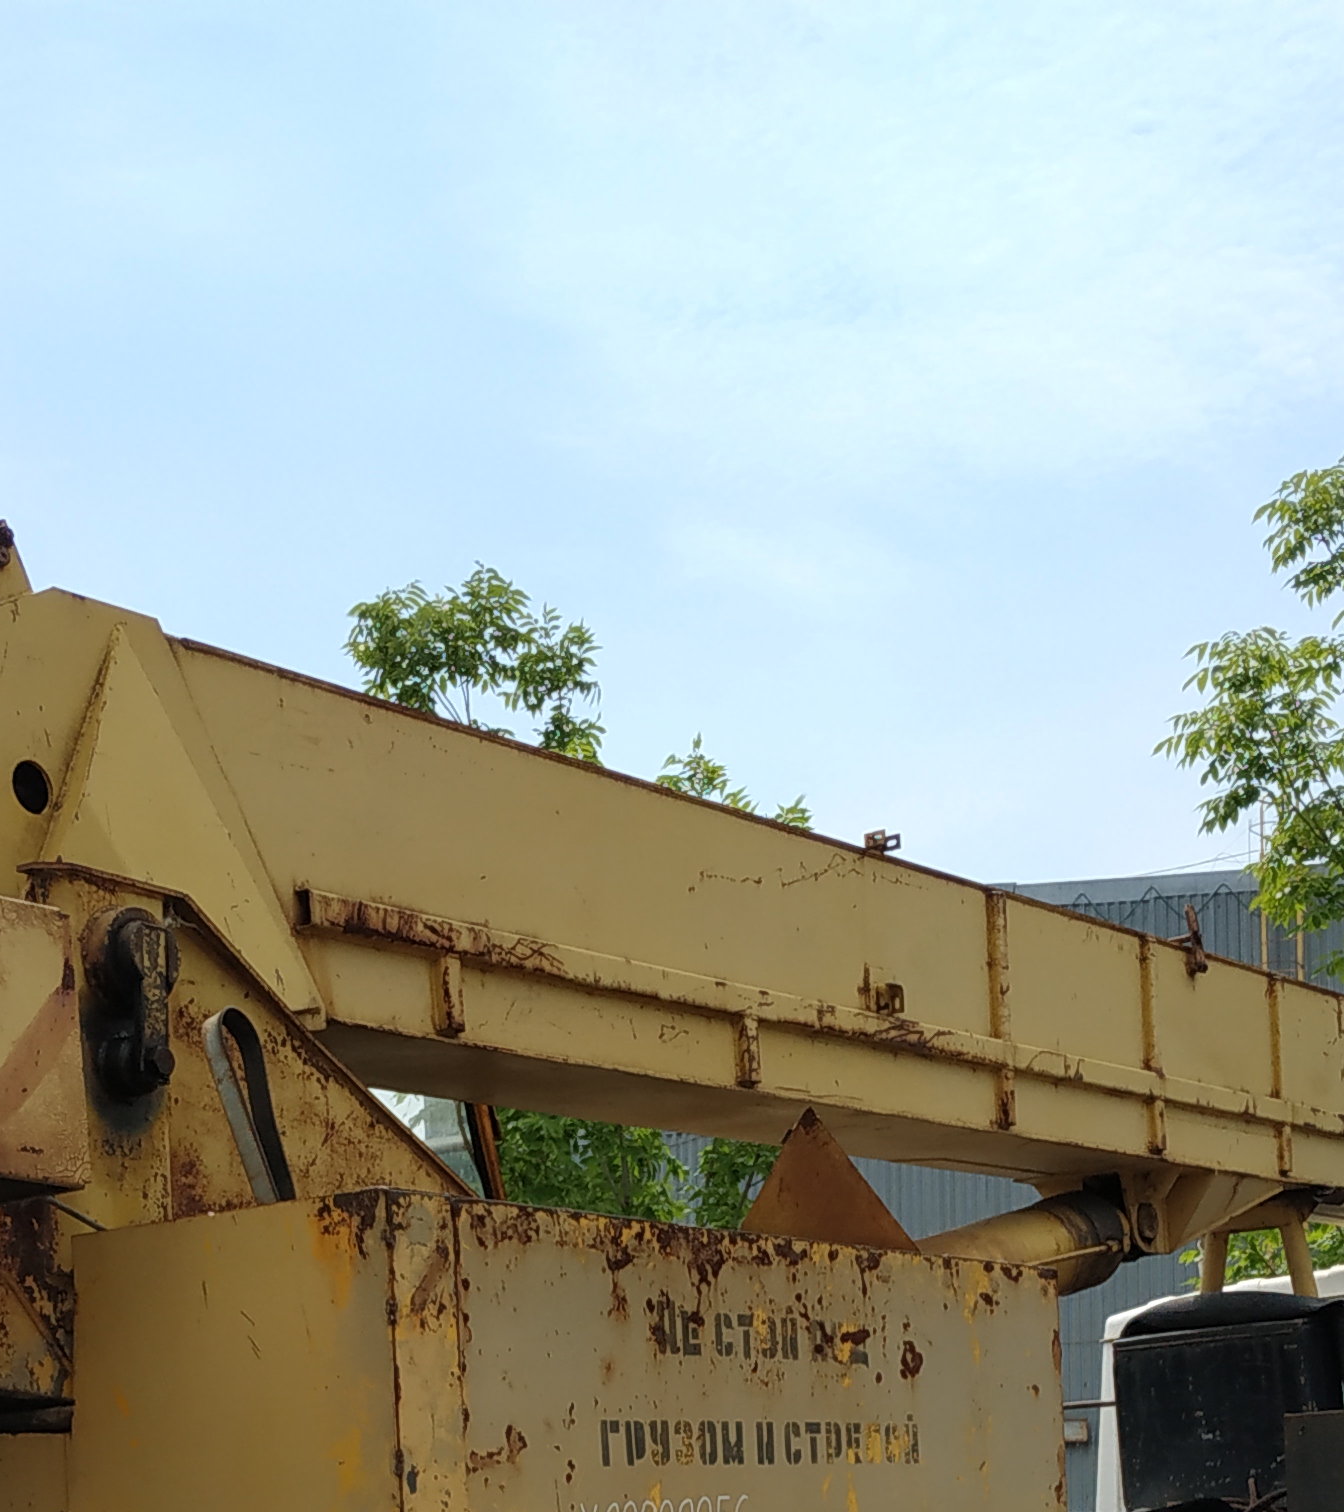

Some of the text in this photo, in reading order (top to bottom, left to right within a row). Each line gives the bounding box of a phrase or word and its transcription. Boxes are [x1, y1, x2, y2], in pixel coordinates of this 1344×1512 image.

[599, 1413, 921, 1467] ГРУЗОМ И СТРЕЛОЙ
